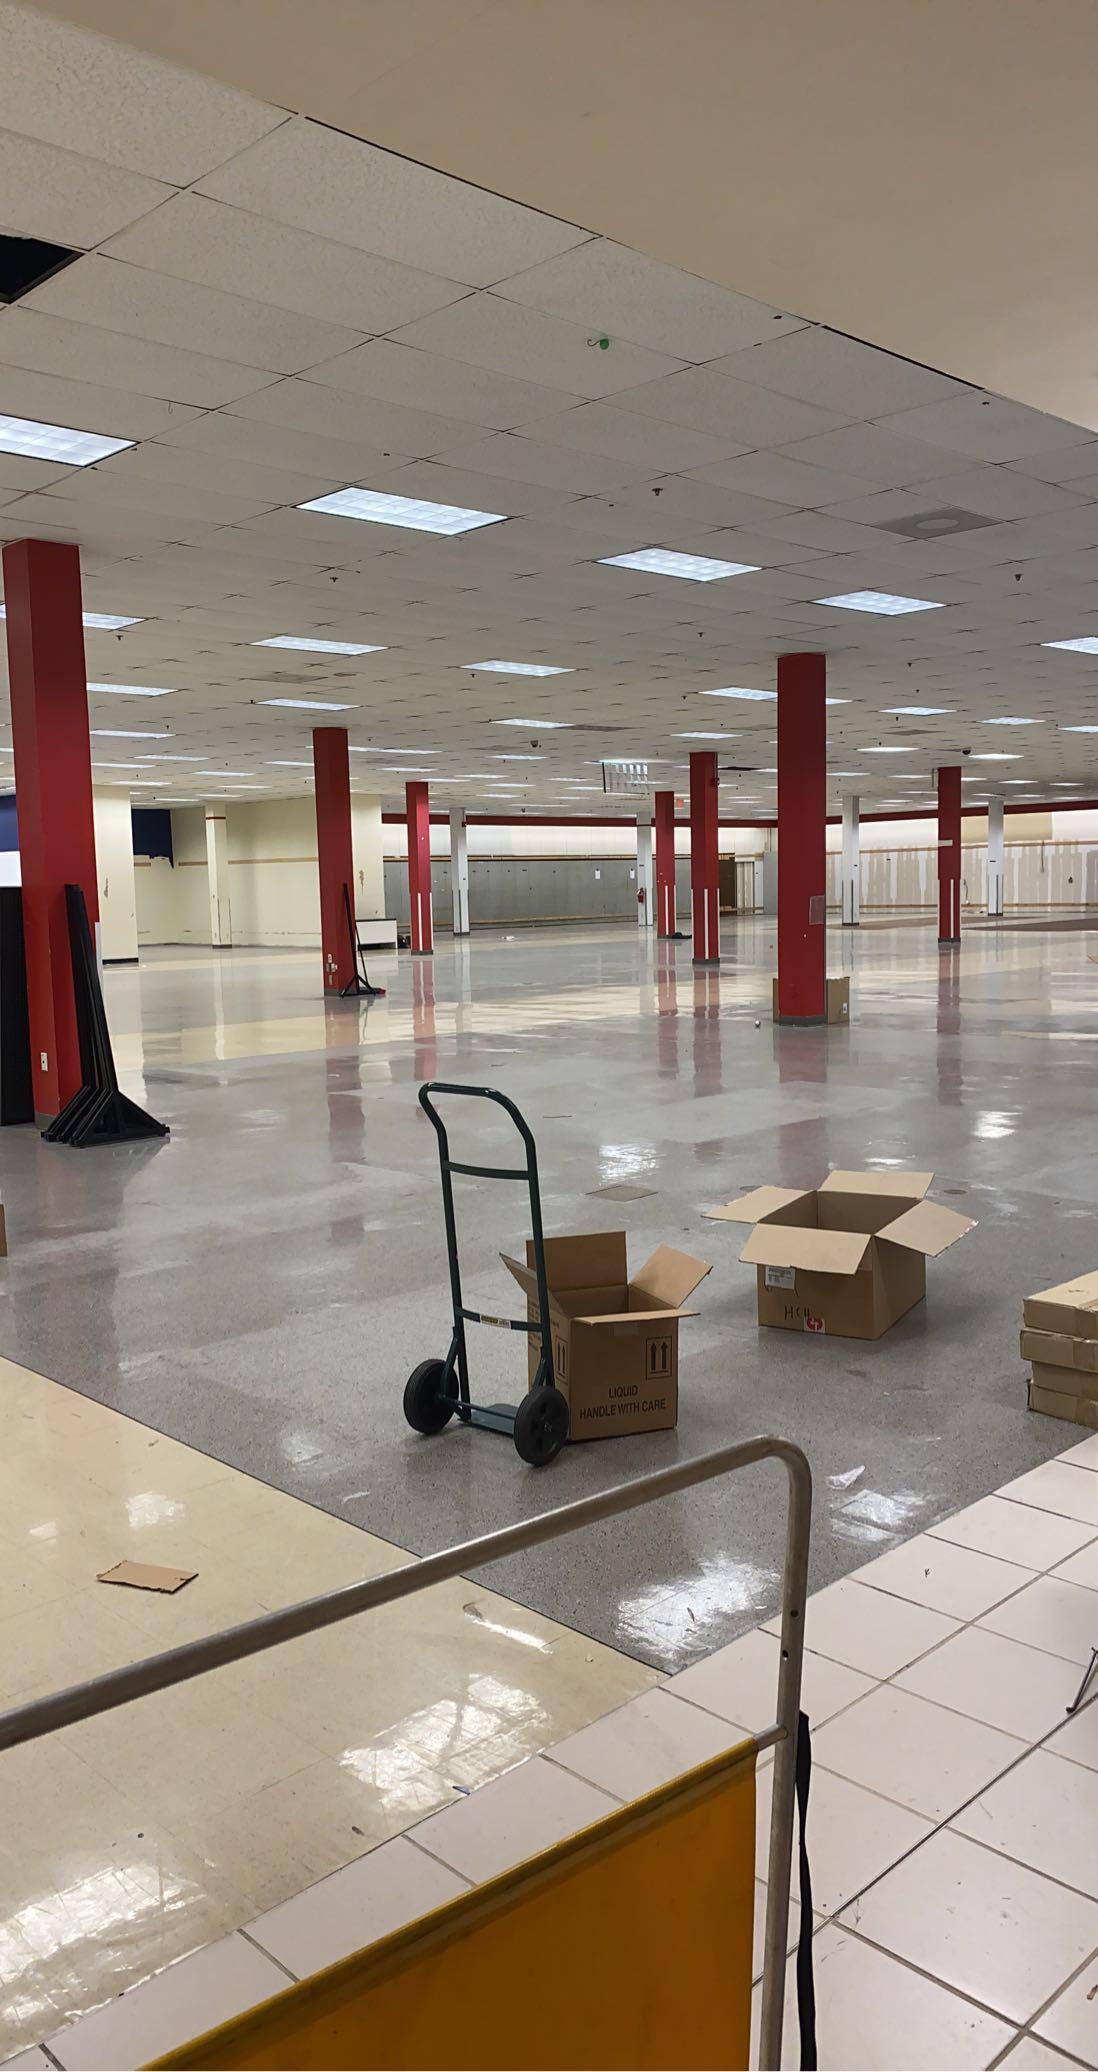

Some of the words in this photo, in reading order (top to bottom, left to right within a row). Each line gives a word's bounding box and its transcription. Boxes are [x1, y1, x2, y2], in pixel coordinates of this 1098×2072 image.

[608, 1385, 638, 1399] LIQUID
[579, 1404, 616, 1420] HANDLE
[617, 1402, 640, 1416] WITH
[642, 1398, 666, 1413] CARE
